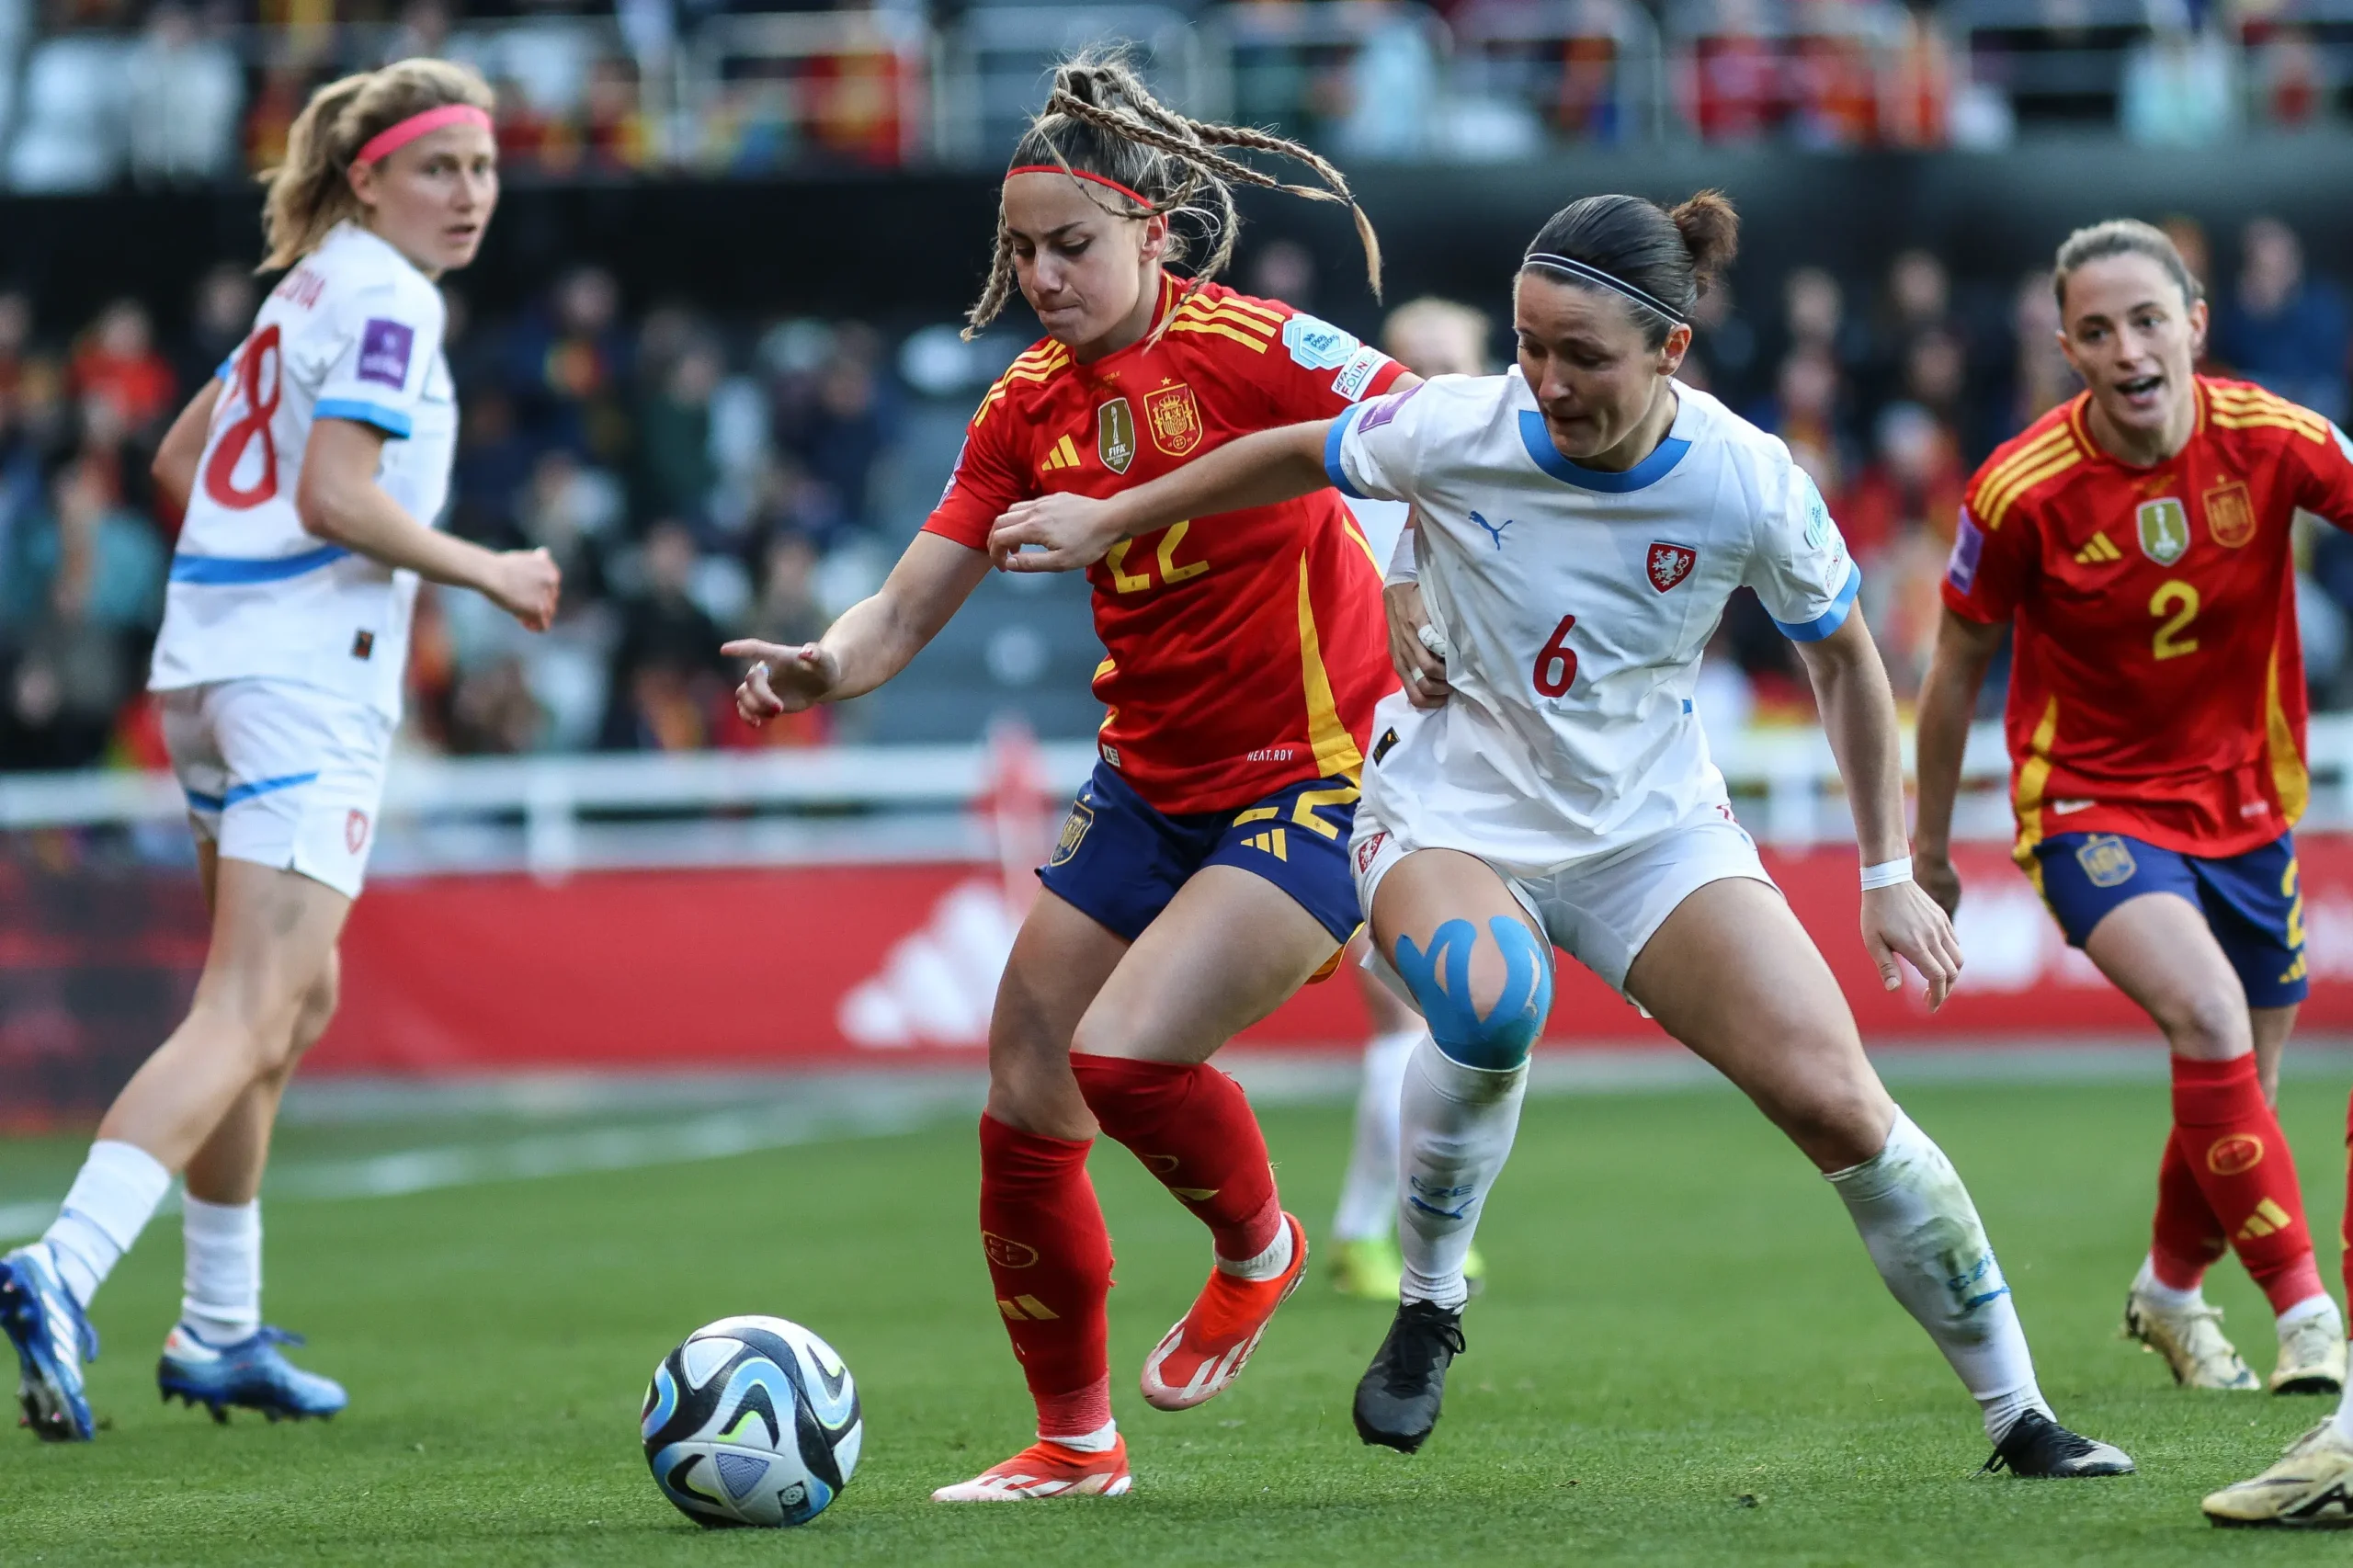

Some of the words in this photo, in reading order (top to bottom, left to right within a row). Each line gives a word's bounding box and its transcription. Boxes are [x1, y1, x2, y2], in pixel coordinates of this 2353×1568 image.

[1334, 371, 1347, 391] UEFA
[1108, 443, 1125, 457] FIFA
[2149, 579, 2200, 661] 2
[1533, 614, 1578, 699] 6
[1246, 749, 1293, 762] HEAT.RDY
[1411, 1176, 1474, 1199] CZE
